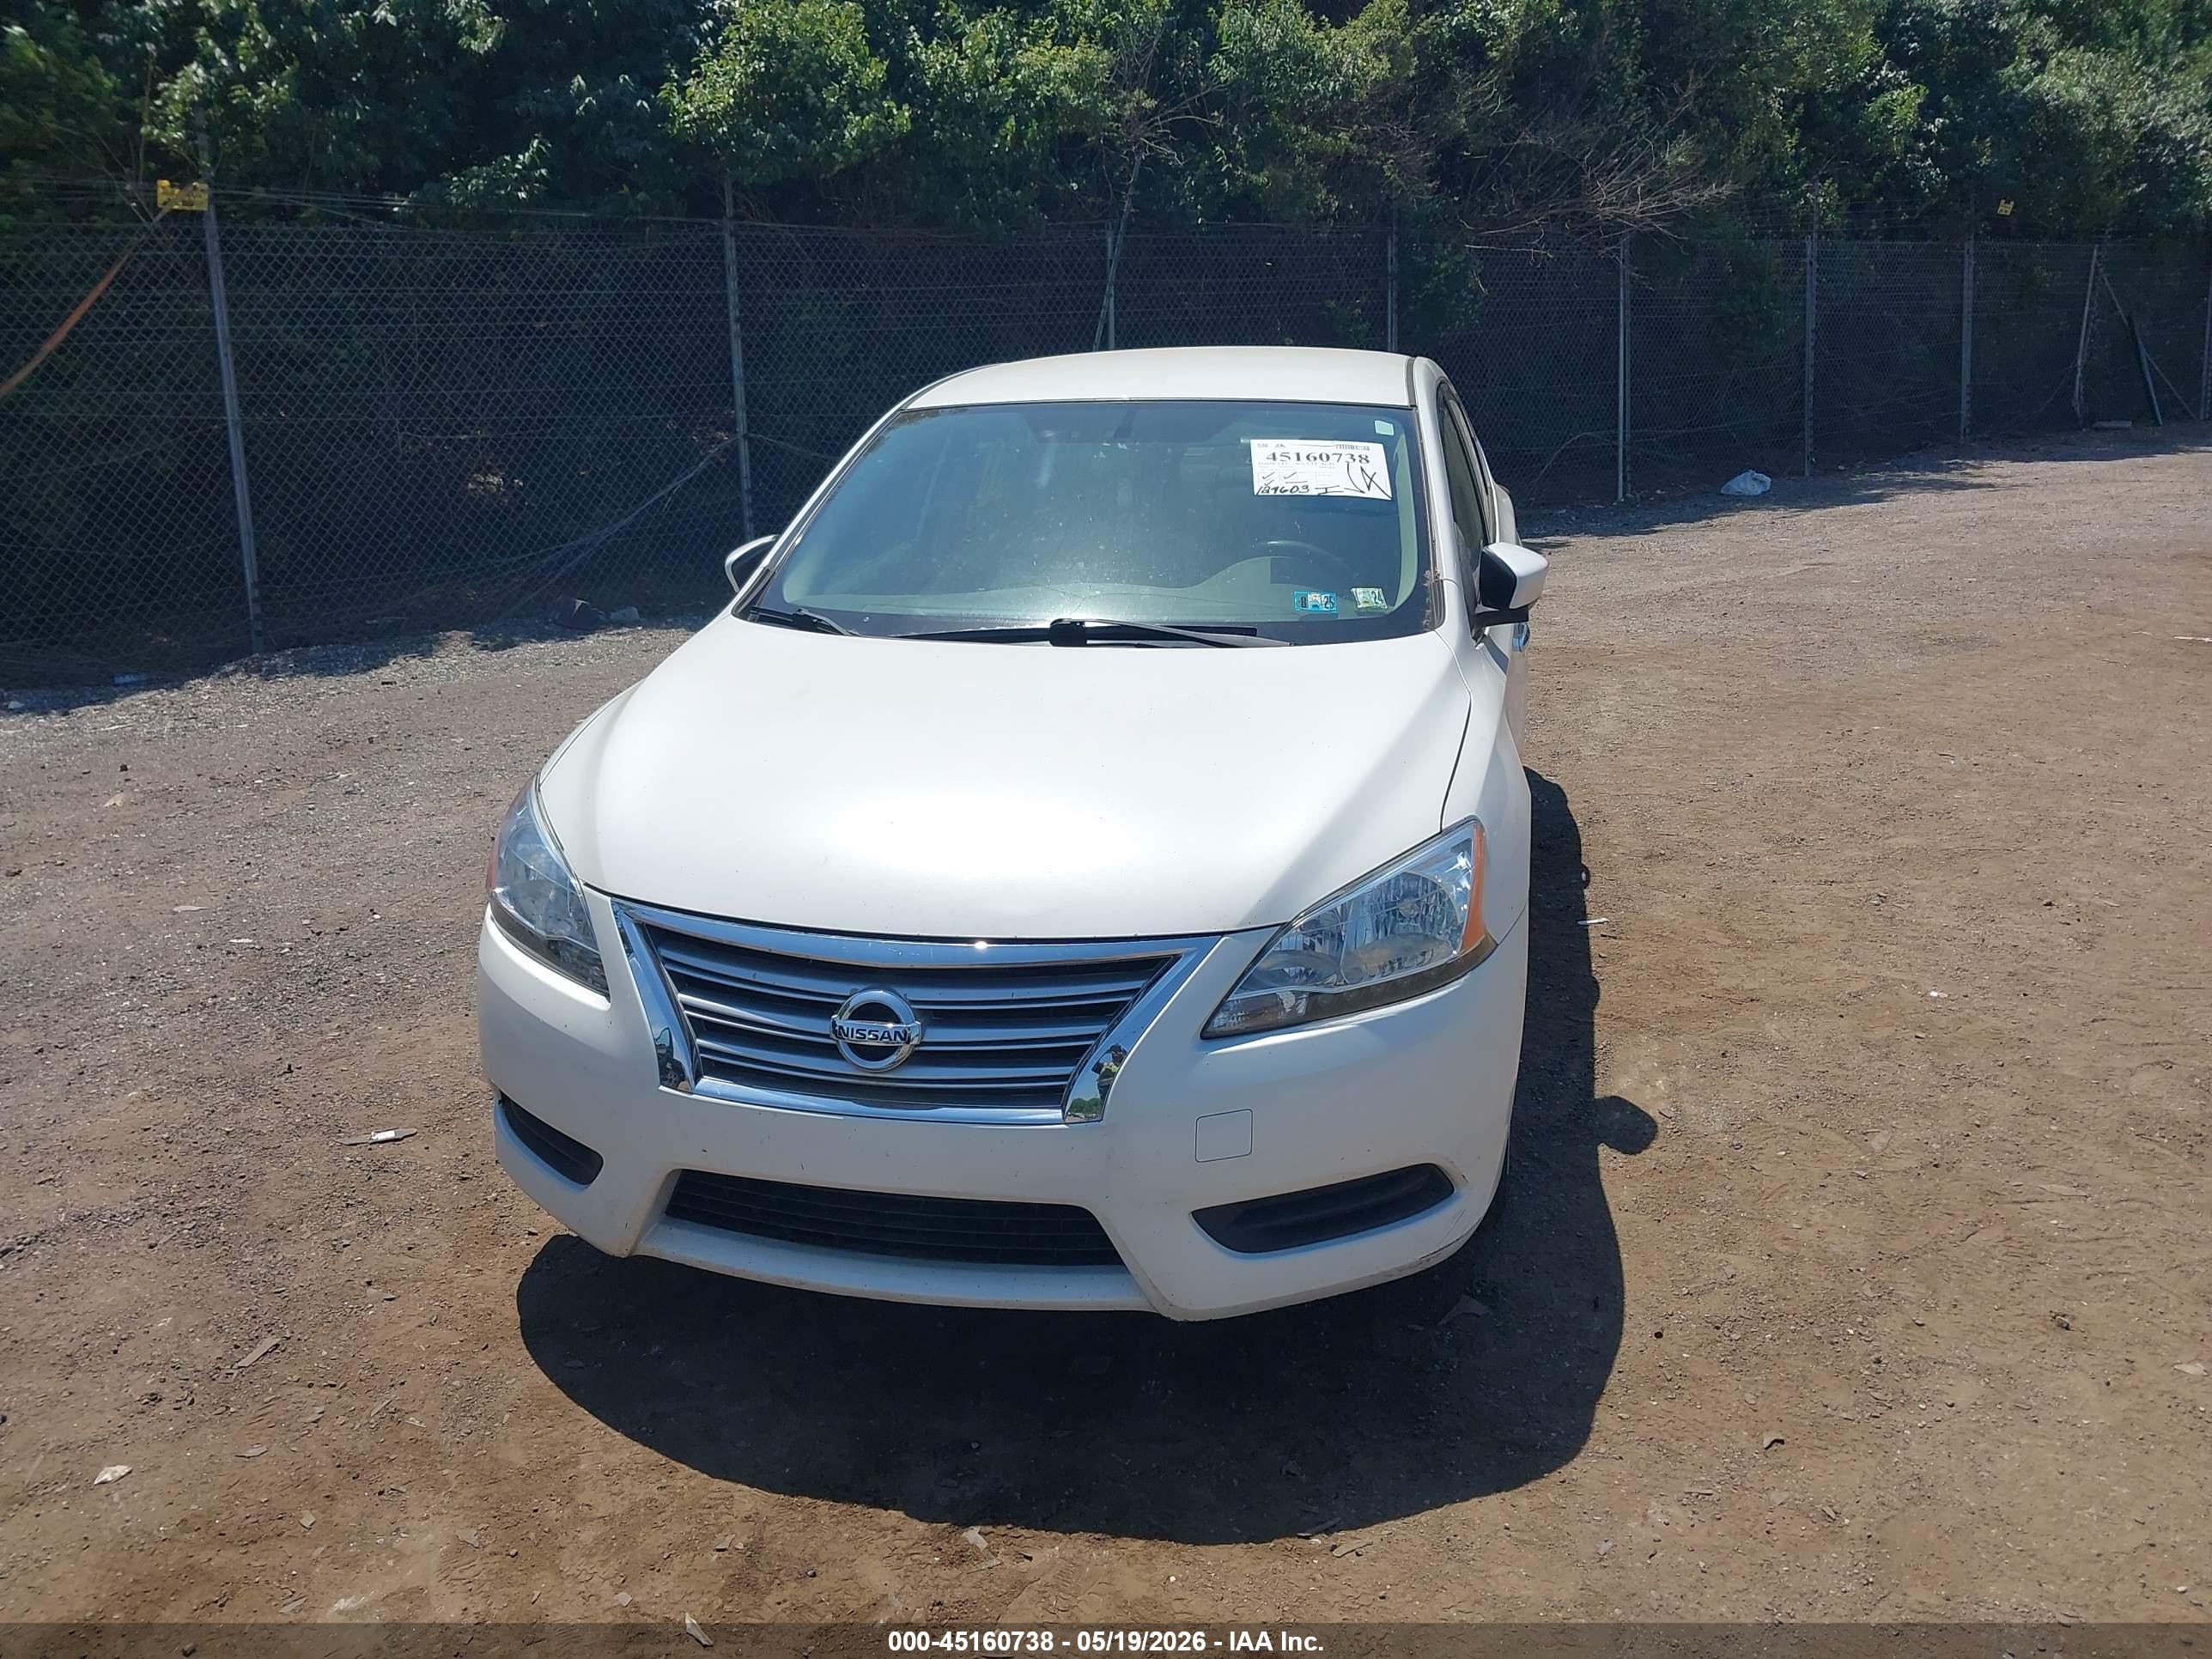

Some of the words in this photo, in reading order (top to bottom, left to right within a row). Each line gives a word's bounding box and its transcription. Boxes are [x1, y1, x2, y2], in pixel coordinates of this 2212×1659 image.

[1266, 452, 1370, 465] 45160738
[1323, 595, 1334, 609] 25
[1371, 590, 1383, 605] 24
[837, 1025, 908, 1042] NISSAN
